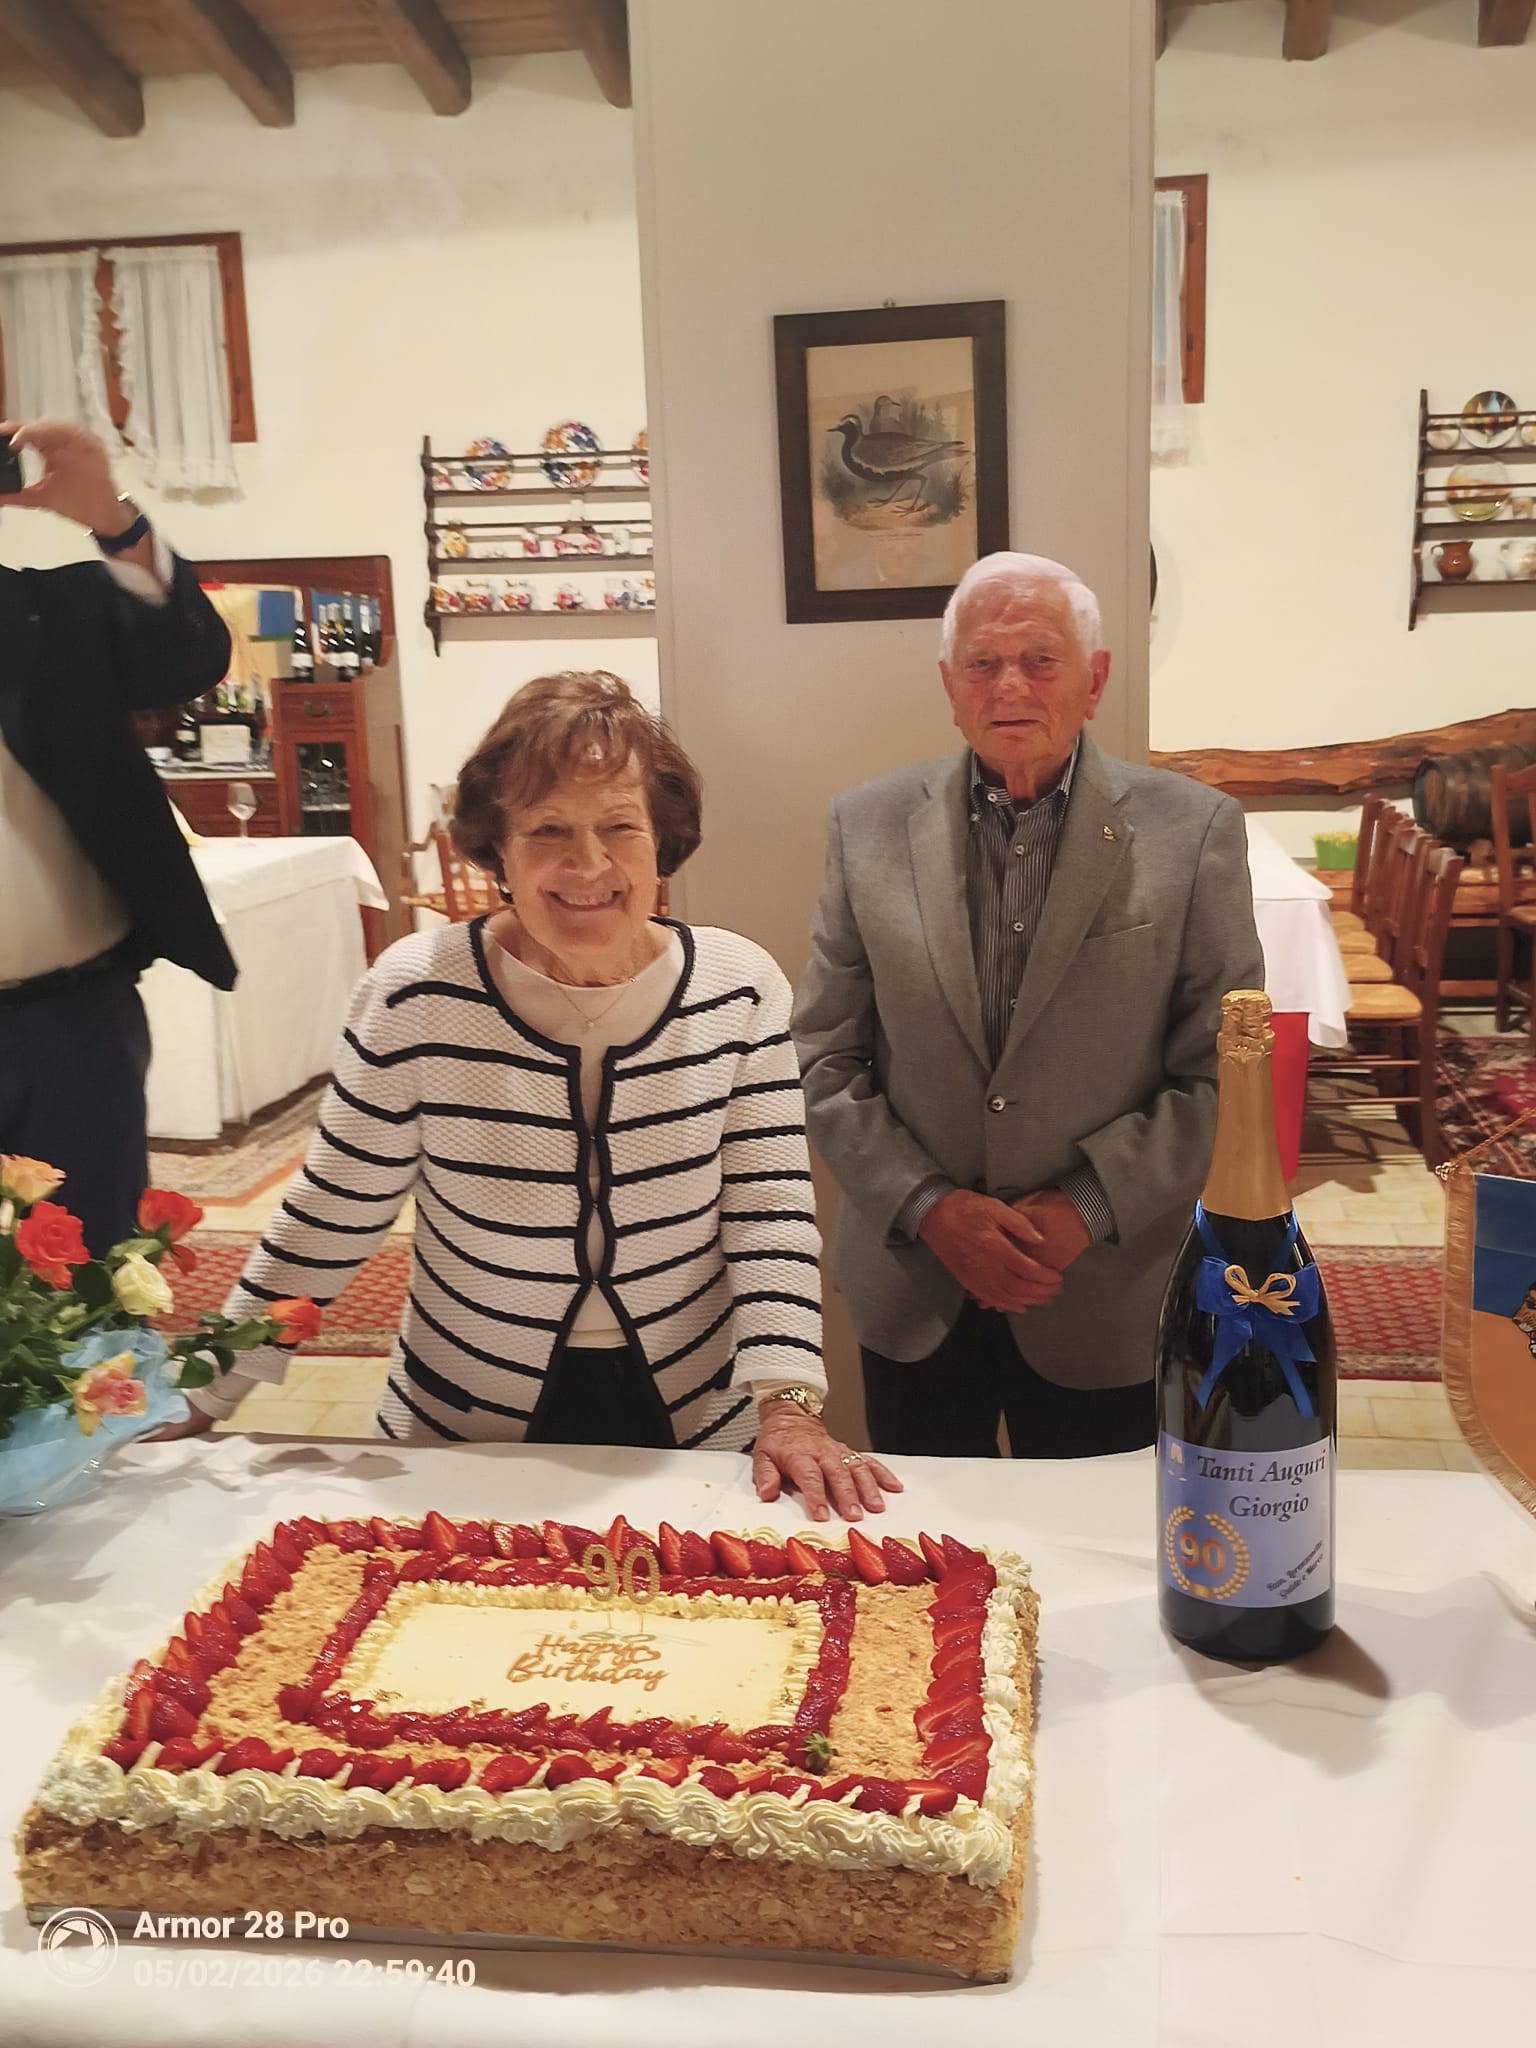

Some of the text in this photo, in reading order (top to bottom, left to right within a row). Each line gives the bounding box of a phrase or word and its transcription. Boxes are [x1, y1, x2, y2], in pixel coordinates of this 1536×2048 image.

[1198, 1449, 1327, 1486] Tanti Auguri
[1229, 1494, 1309, 1522] Giorgio
[1179, 1532, 1226, 1576] 90
[582, 1544, 660, 1605] 90
[535, 1634, 655, 1667] Happy
[506, 1652, 669, 1692] Birthday
